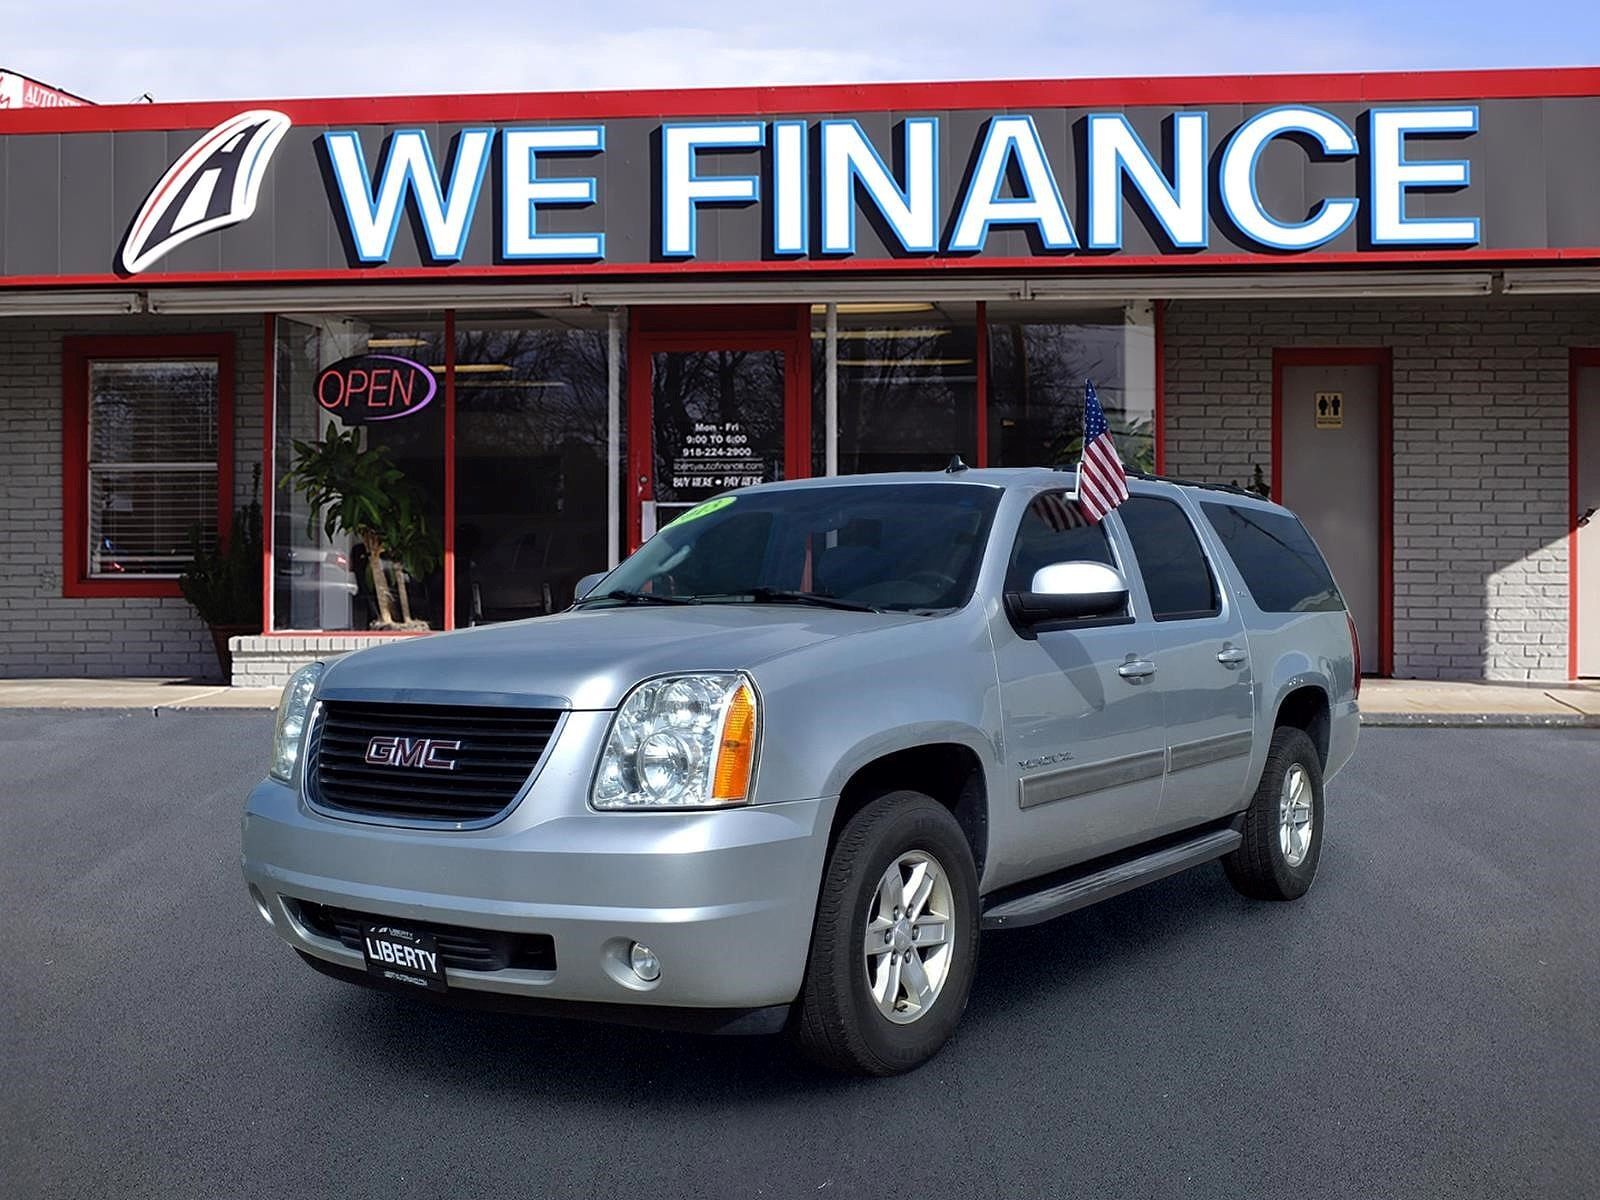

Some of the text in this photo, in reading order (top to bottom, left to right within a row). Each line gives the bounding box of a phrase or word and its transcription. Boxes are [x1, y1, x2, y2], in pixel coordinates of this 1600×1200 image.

[24, 85, 58, 107] AUTO
[323, 105, 1480, 262] WE FINANCE
[318, 369, 415, 408] OPEN
[686, 435, 748, 444] 9:00 TO 6:00
[695, 424, 717, 432] Mon
[725, 423, 739, 431] Fri
[683, 448, 752, 457] 918-224-2900
[365, 736, 461, 770] GMC
[366, 937, 437, 973] LIBERTY
